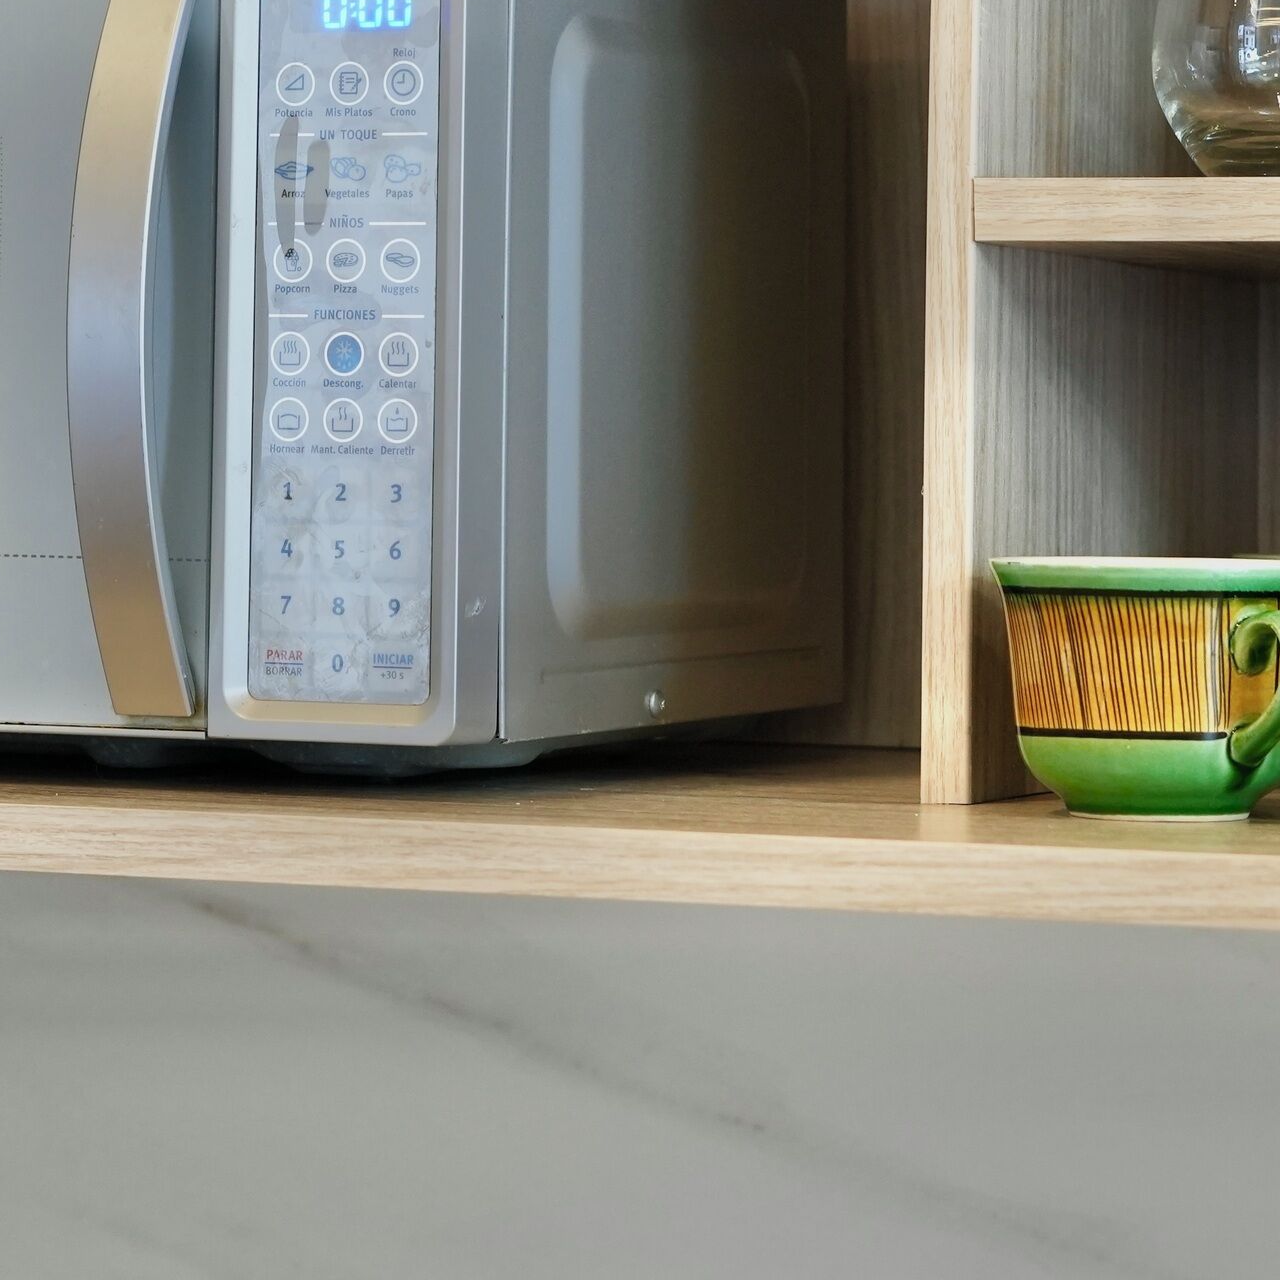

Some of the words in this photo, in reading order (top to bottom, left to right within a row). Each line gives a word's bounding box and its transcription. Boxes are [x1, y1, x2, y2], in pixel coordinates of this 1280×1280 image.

[393, 47, 416, 59] Reloj
[275, 108, 313, 117] Potencia
[326, 108, 342, 117] Mis
[345, 108, 373, 117] Platos
[390, 107, 416, 117] Crono
[319, 129, 335, 140] UN
[341, 129, 377, 140] TOQUE
[281, 189, 305, 198] Arroz
[325, 188, 370, 200] Vegetales
[386, 188, 414, 200] Papas
[330, 215, 364, 228] NIÑOS
[275, 284, 311, 296] Popcorn
[333, 284, 358, 294] Pizza
[381, 284, 419, 297] Nuggets
[314, 309, 376, 321] FUNCIONES
[323, 378, 364, 390] Descong.
[379, 378, 417, 389] Calentar
[269, 444, 305, 455] Hornear
[311, 444, 337, 455] Mant.
[338, 444, 374, 455] Caliente
[380, 445, 415, 456] Derretir
[283, 482, 292, 500] 1
[335, 483, 346, 501] 2
[390, 484, 402, 503] 3
[280, 540, 293, 558] 4
[334, 540, 344, 558] 5
[389, 541, 401, 560] 6
[280, 596, 291, 614] 7
[332, 597, 344, 616] 8
[388, 599, 401, 617] 9
[266, 648, 303, 663] PARAR
[373, 653, 414, 665] INICIAR
[332, 654, 344, 672] 0
[265, 665, 302, 677] BORRAR
[380, 669, 397, 679] +30
